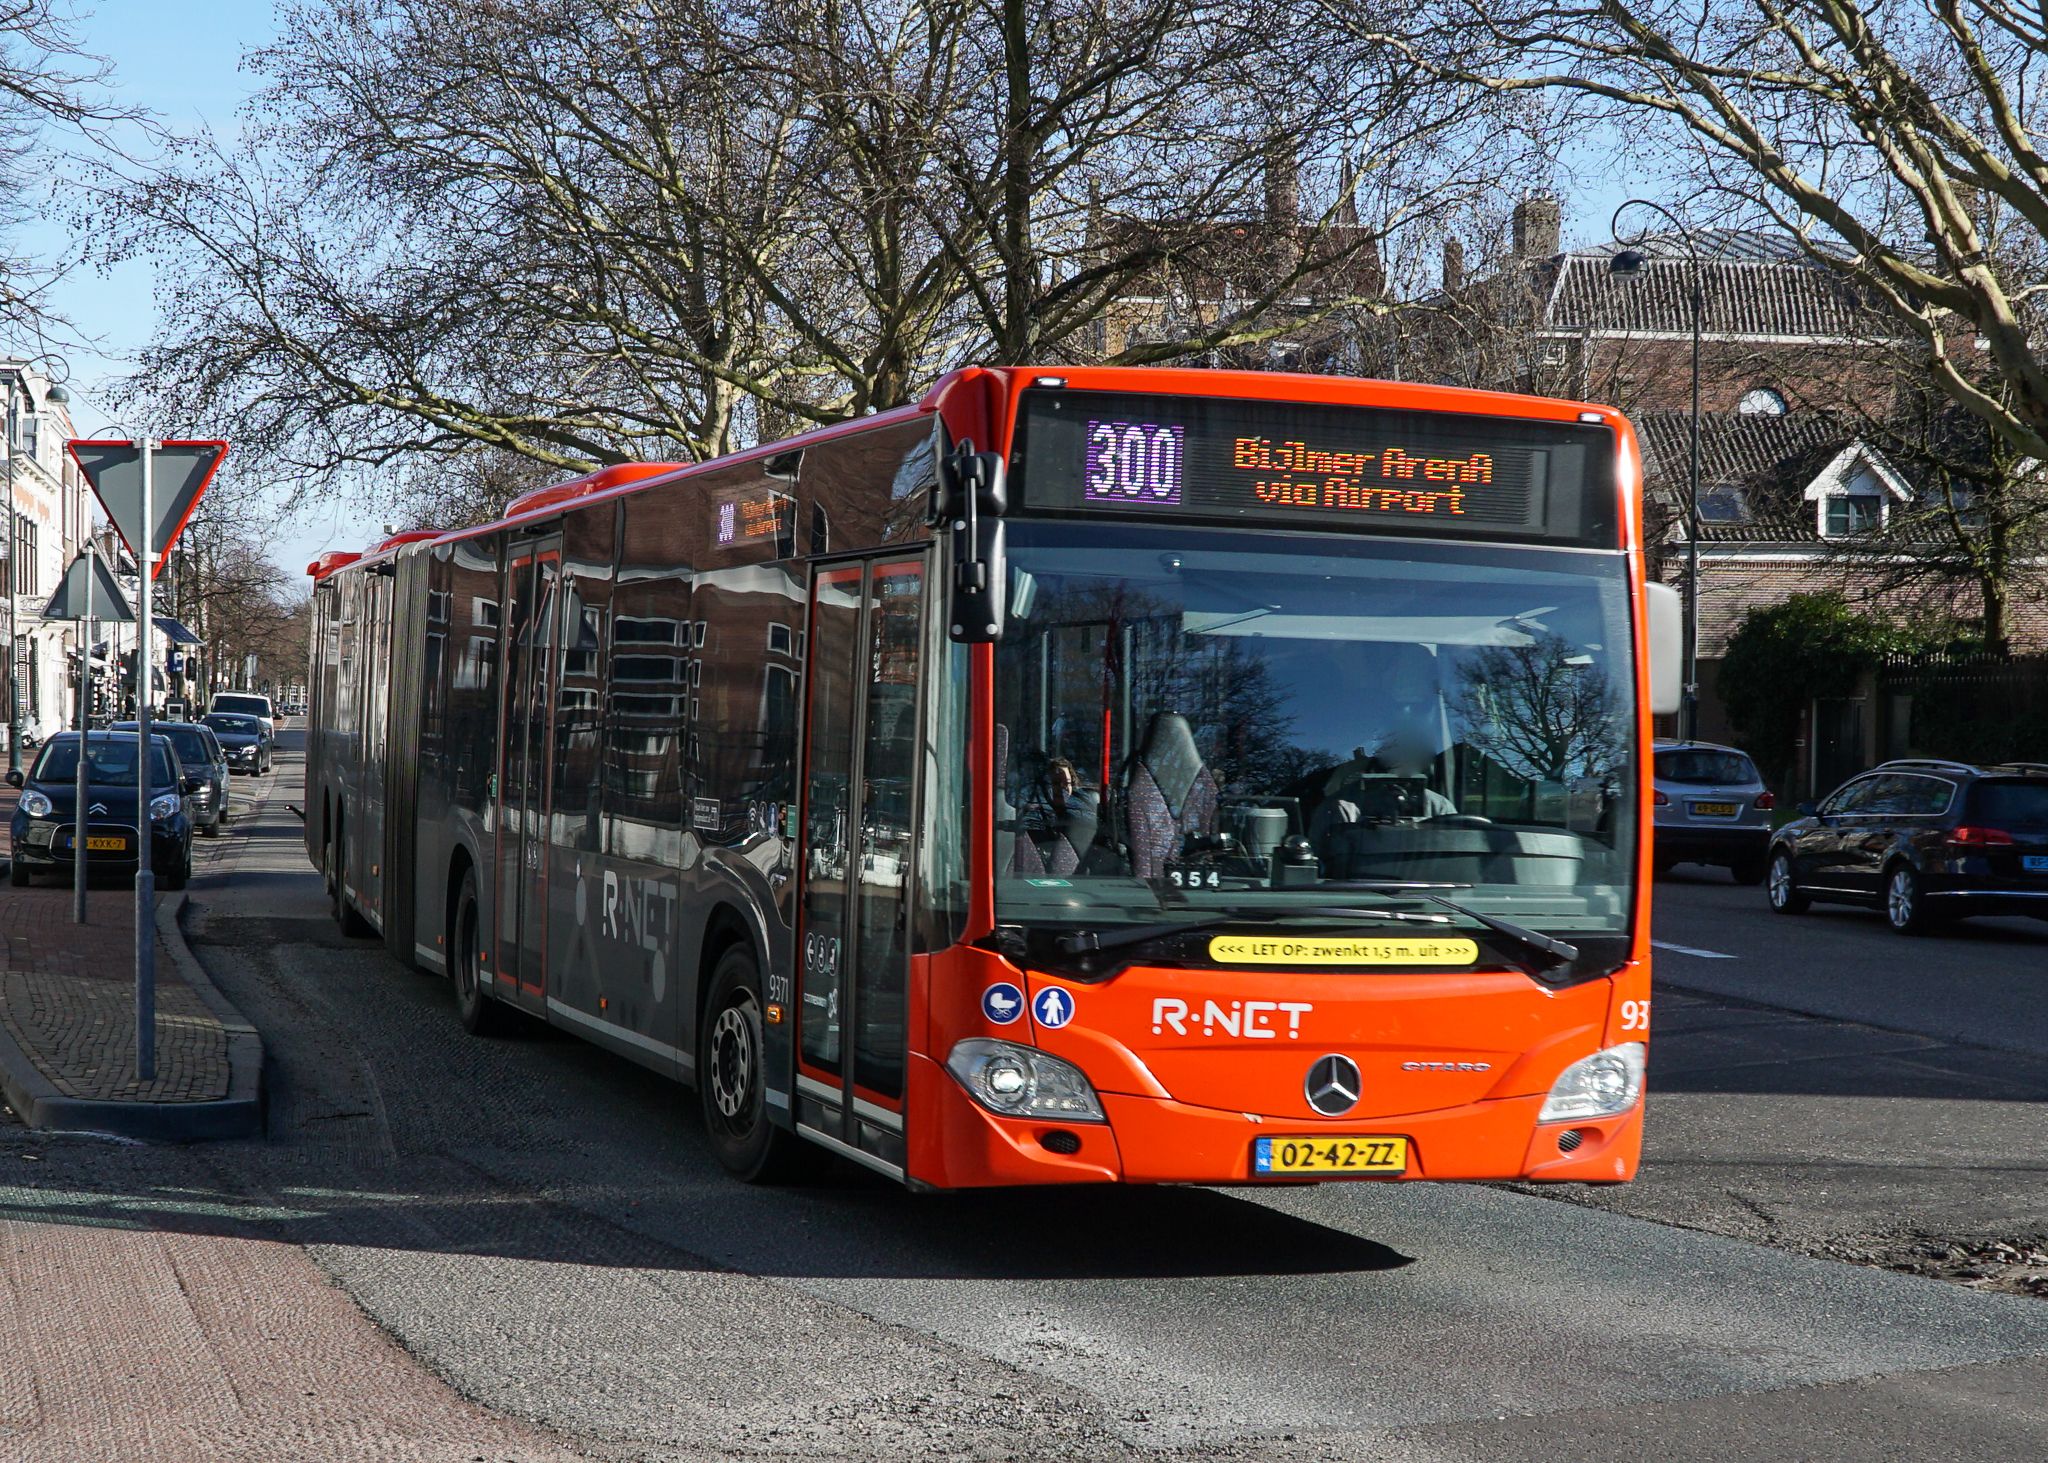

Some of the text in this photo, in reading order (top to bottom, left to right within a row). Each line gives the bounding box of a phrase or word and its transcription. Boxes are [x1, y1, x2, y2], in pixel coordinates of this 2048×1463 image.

[1091, 424, 1176, 497] 300
[1234, 437, 1376, 475] Bijlmer
[1256, 474, 1466, 515] via Airport
[174, 651, 183, 665] P
[1170, 871, 1220, 888] 354
[1252, 943, 1440, 960] LET OP: zwenkt 1,5 m. uit
[769, 974, 789, 1004] 9371
[1620, 1000, 1652, 1030] 93
[1401, 1061, 1492, 1073] CITARO
[1281, 1143, 1396, 1167] 02-42-ZZ
